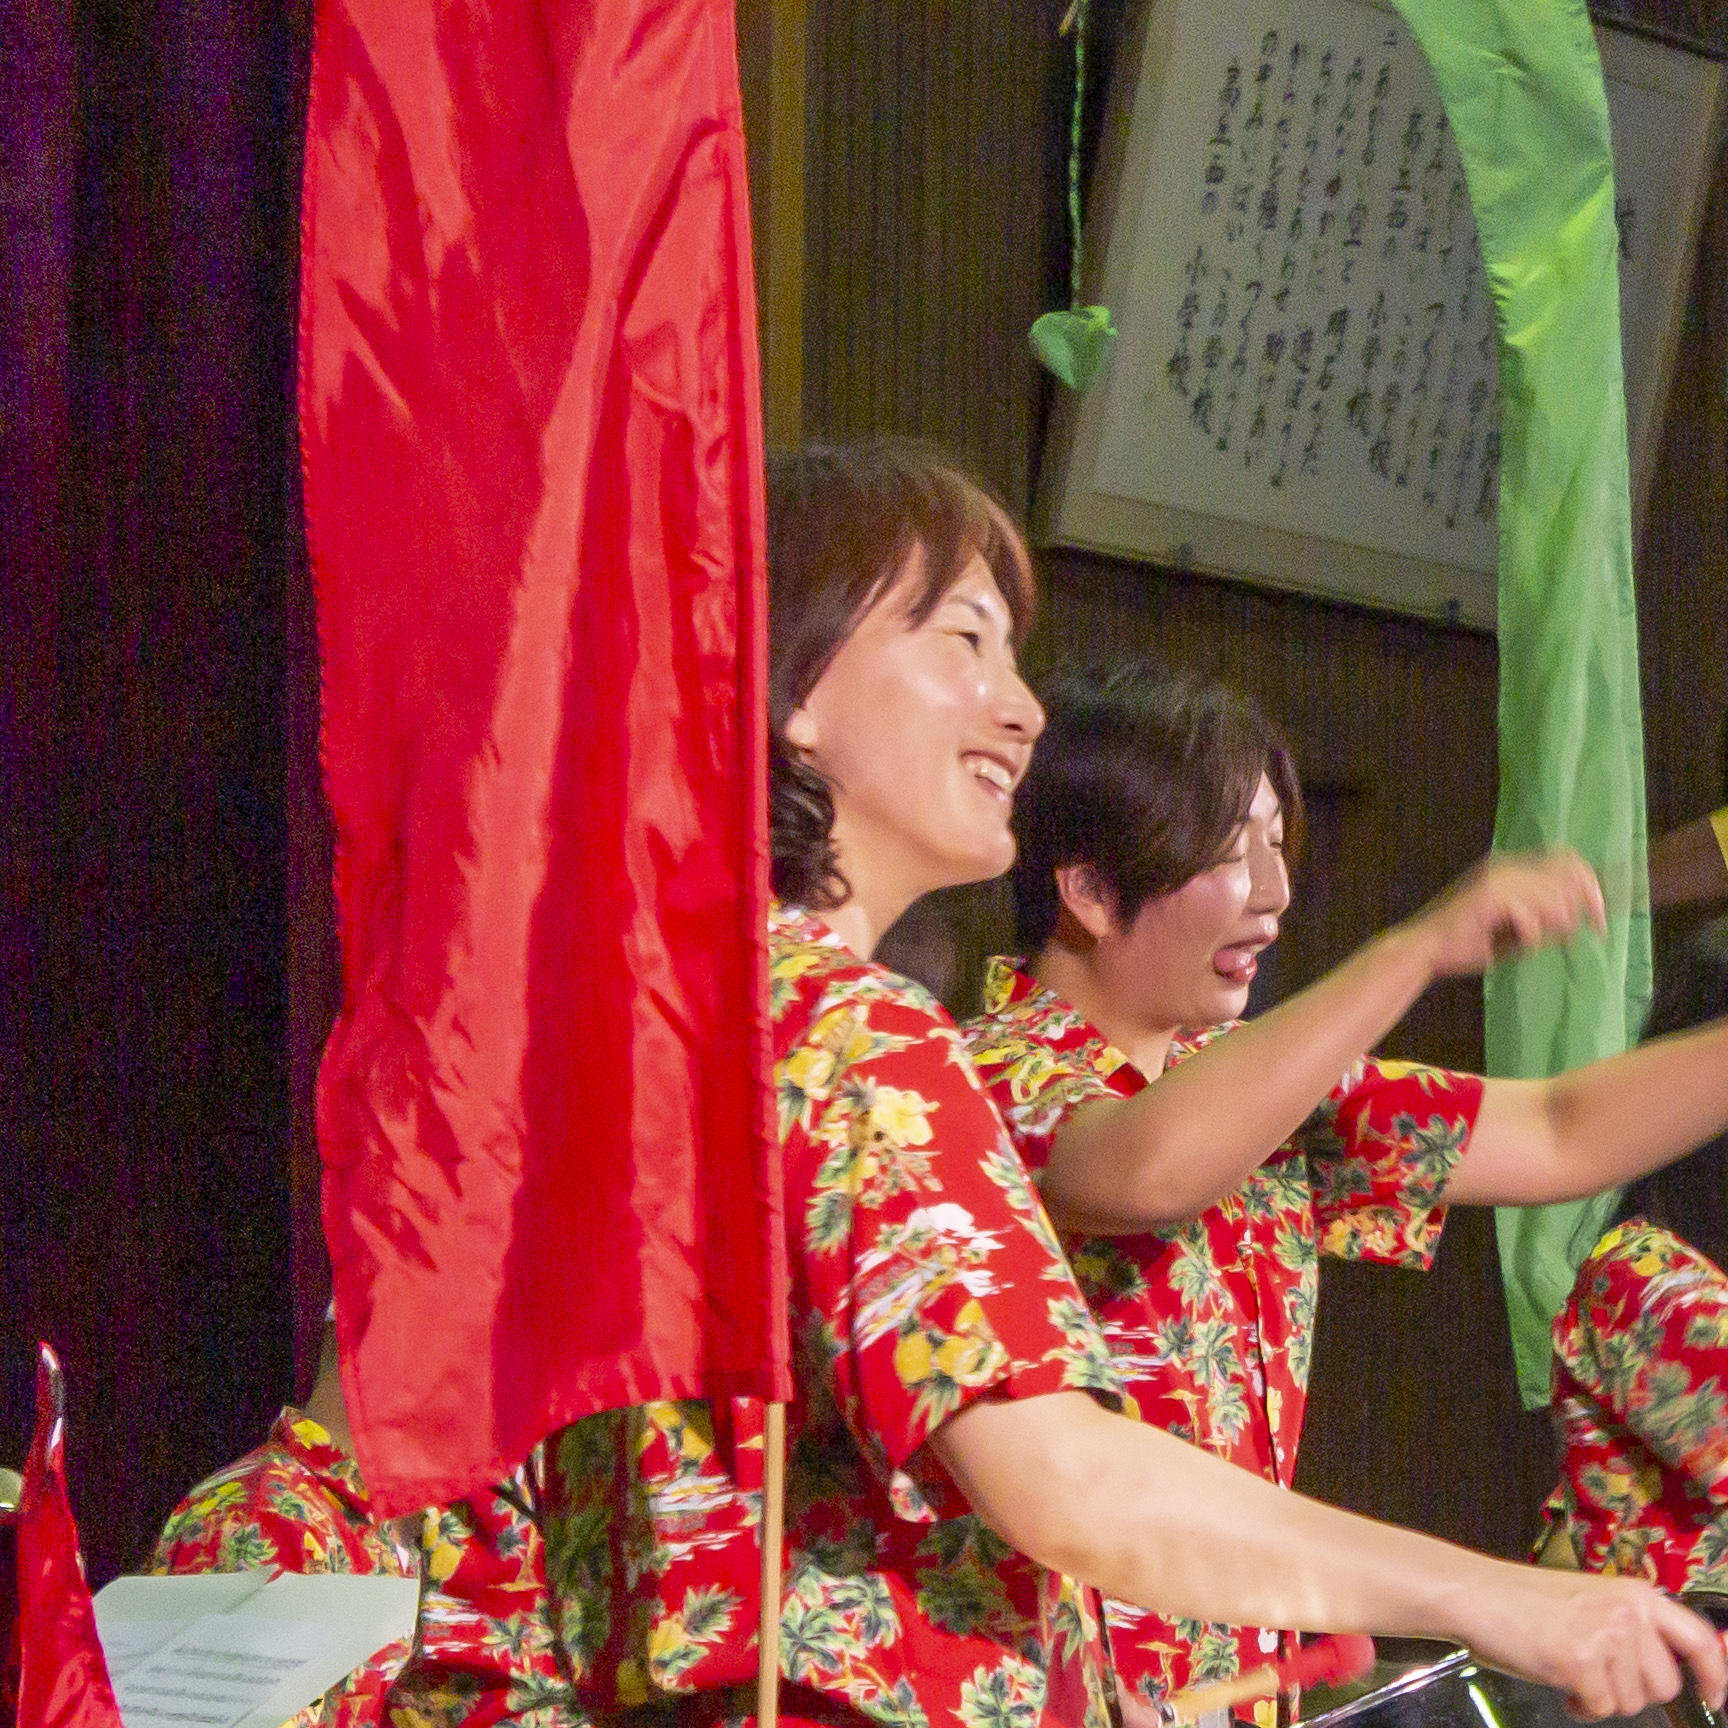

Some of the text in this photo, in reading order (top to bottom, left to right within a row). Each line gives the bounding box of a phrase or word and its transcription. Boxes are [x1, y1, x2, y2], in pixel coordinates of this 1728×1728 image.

[1163, 245, 1208, 397] 小学校
[1343, 288, 1389, 437] 小学校
